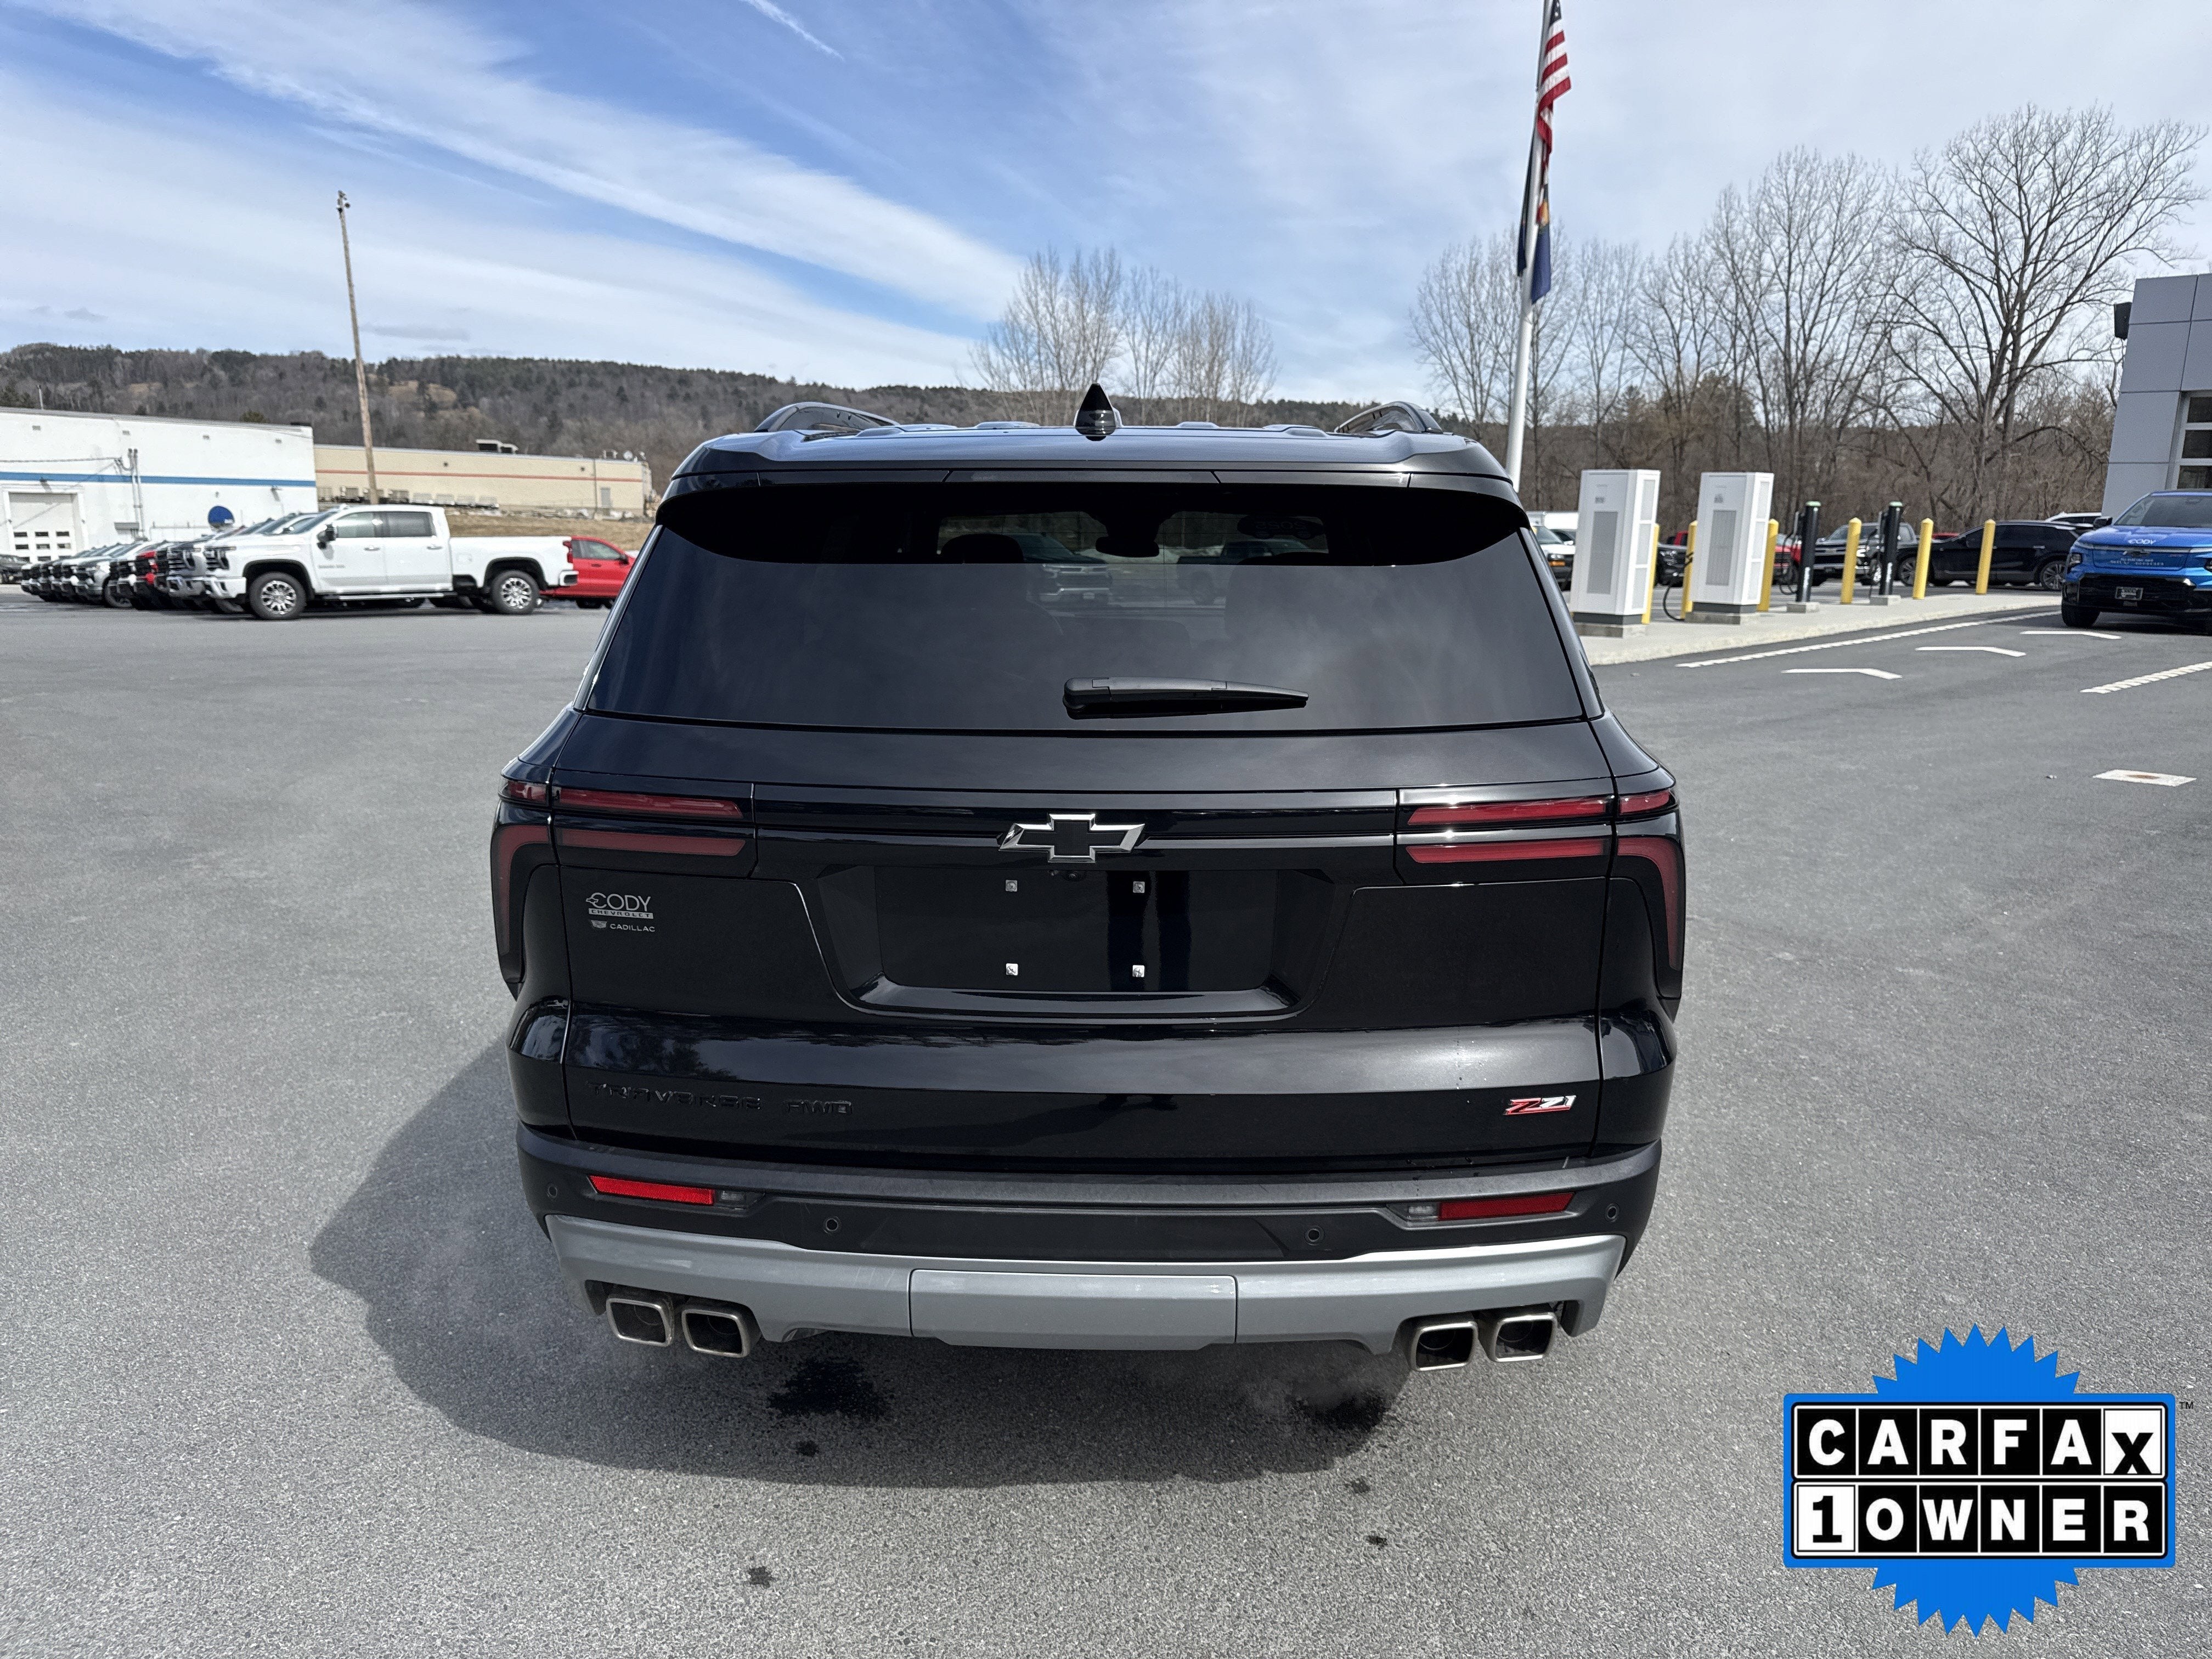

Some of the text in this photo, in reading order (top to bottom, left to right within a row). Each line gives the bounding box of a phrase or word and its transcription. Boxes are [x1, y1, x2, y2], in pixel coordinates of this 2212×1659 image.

[586, 893, 651, 911] CODY
[591, 909, 651, 918] CHEVROLET
[610, 923, 656, 932] CADILLAC
[585, 1082, 853, 1114] TRAVERSE AWD
[1504, 1095, 1576, 1115] Z71
